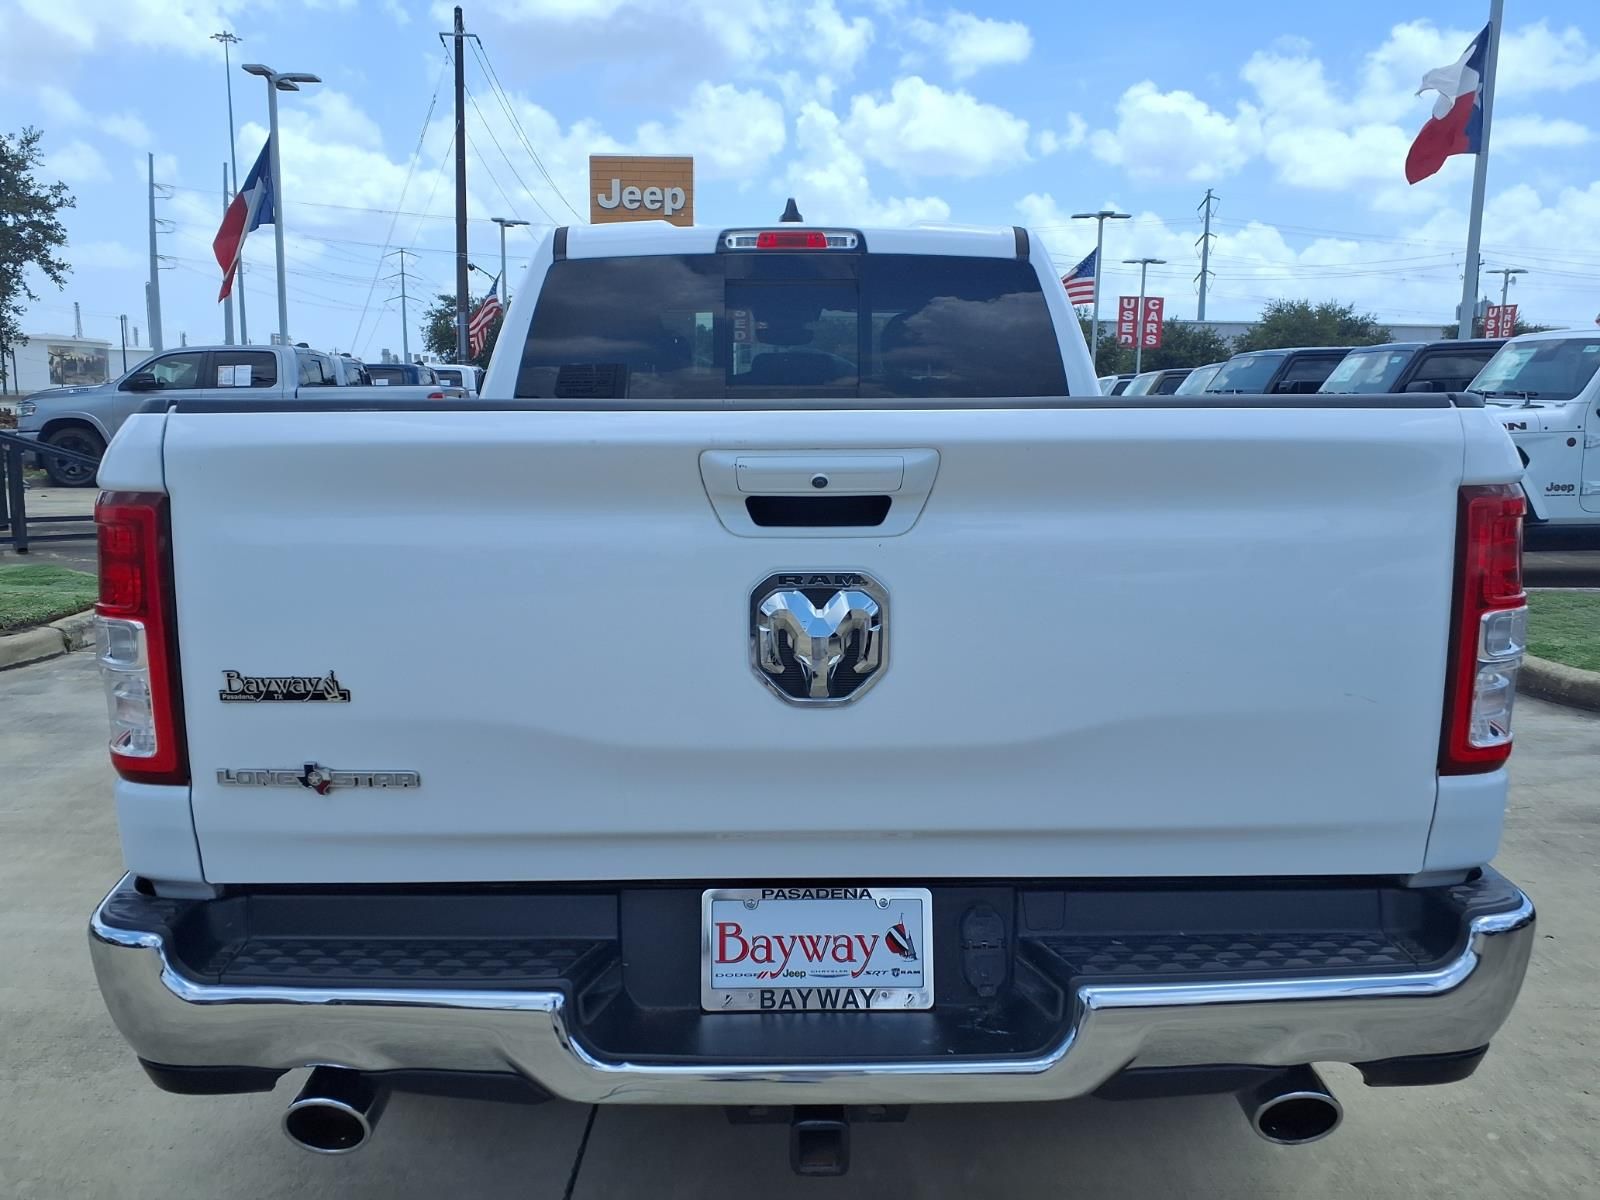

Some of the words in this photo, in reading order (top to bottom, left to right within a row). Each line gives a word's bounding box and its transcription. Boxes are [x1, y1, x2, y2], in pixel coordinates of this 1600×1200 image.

[597, 178, 686, 216] Jeep
[1120, 298, 1135, 344] USED
[1145, 300, 1160, 345] CARS
[1545, 482, 1575, 493] Jeep
[778, 575, 868, 586] RAM
[221, 669, 322, 702] Bayway
[216, 768, 299, 787] LONE
[329, 769, 421, 788] STAR
[761, 888, 873, 900] PASADENA
[714, 922, 881, 979] Bayway
[782, 968, 807, 980] Jeep
[760, 988, 877, 1010] BAYWAY
